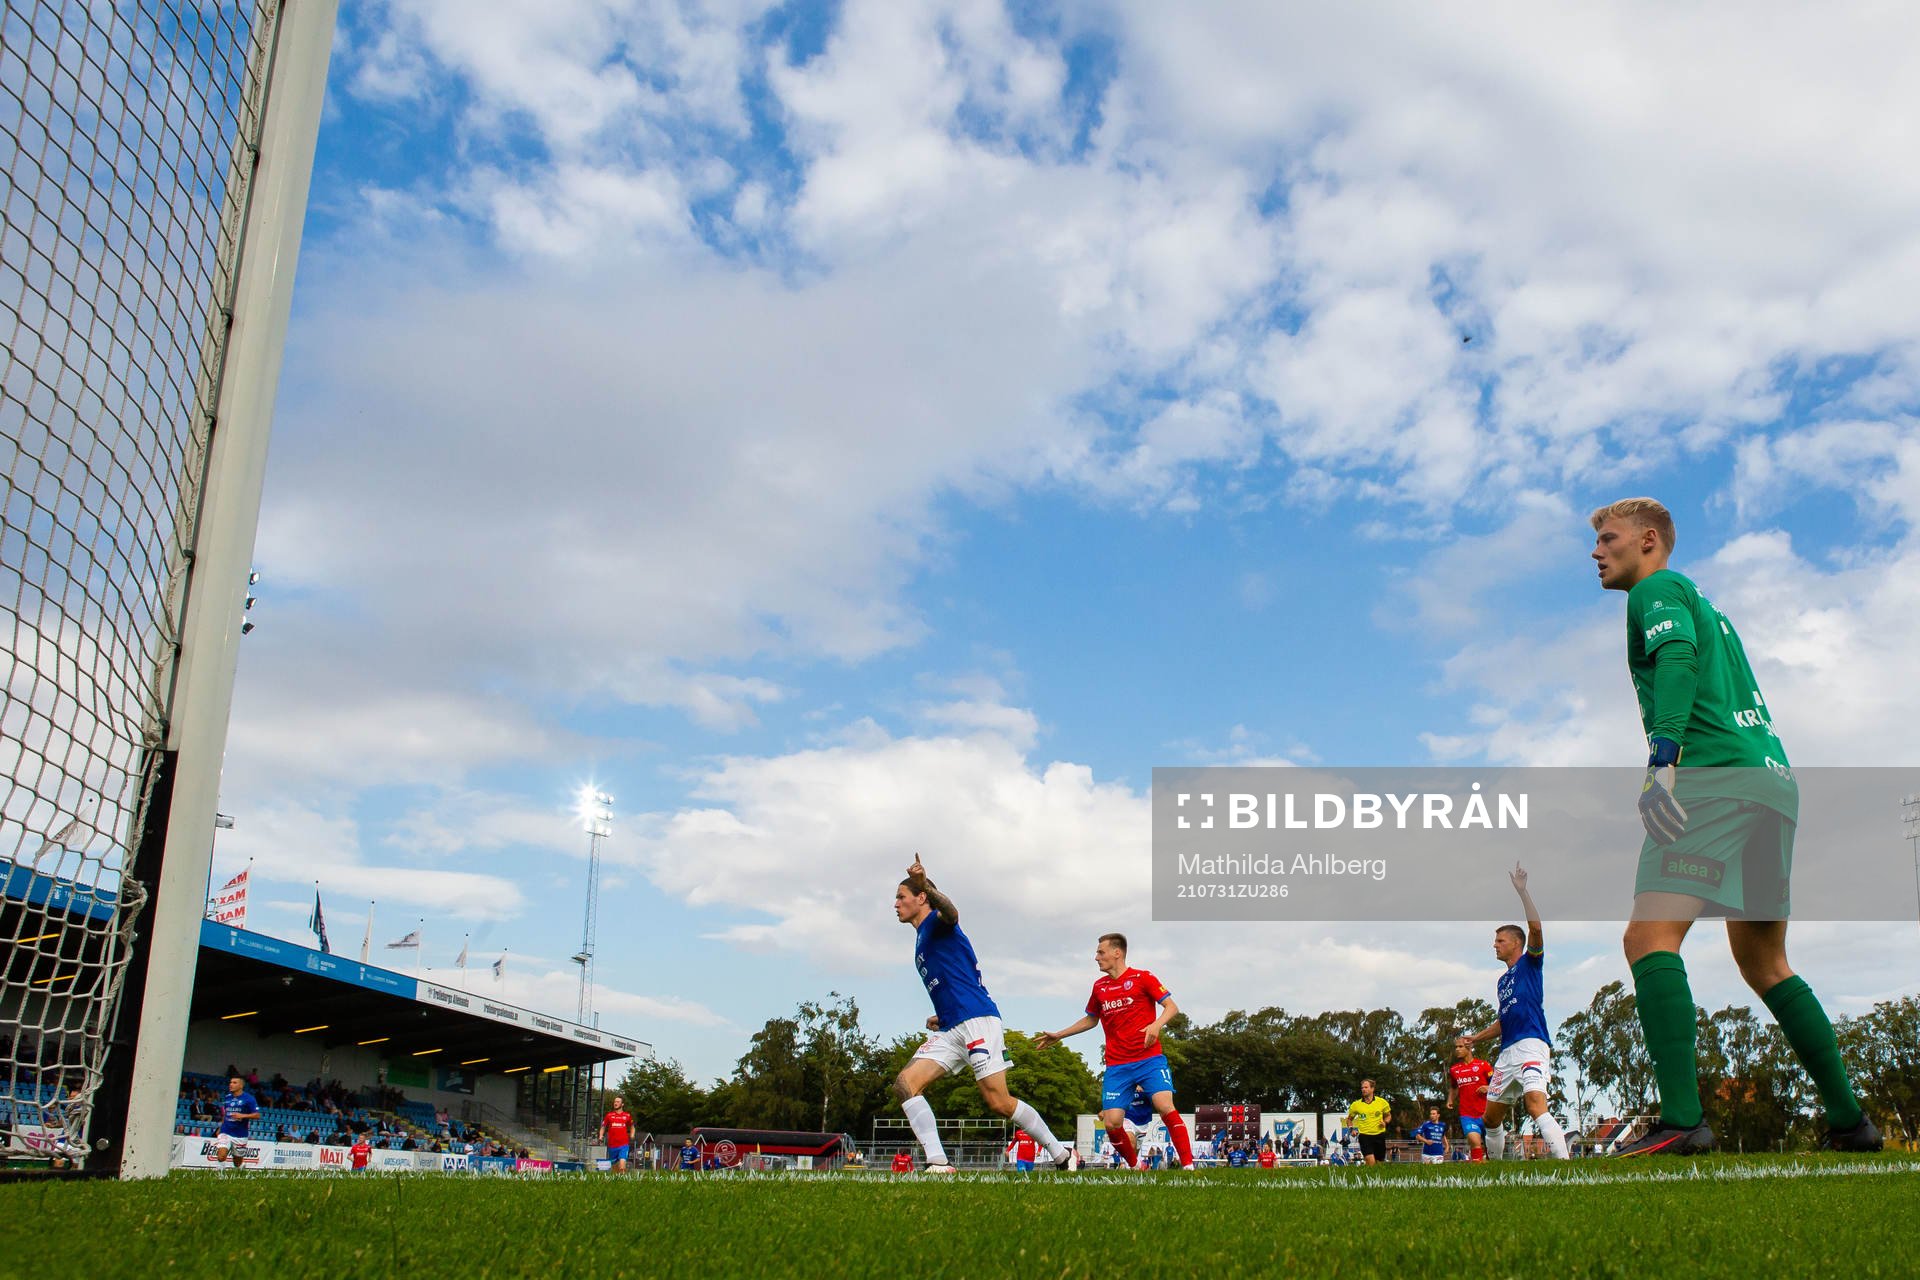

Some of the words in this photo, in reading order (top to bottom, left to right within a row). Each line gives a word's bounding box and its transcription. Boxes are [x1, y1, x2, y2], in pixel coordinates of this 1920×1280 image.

[1645, 620, 1673, 640] MVB
[1667, 856, 1709, 878] akea
[1160, 1069, 1172, 1080] 11
[320, 1148, 344, 1165] MAXI
